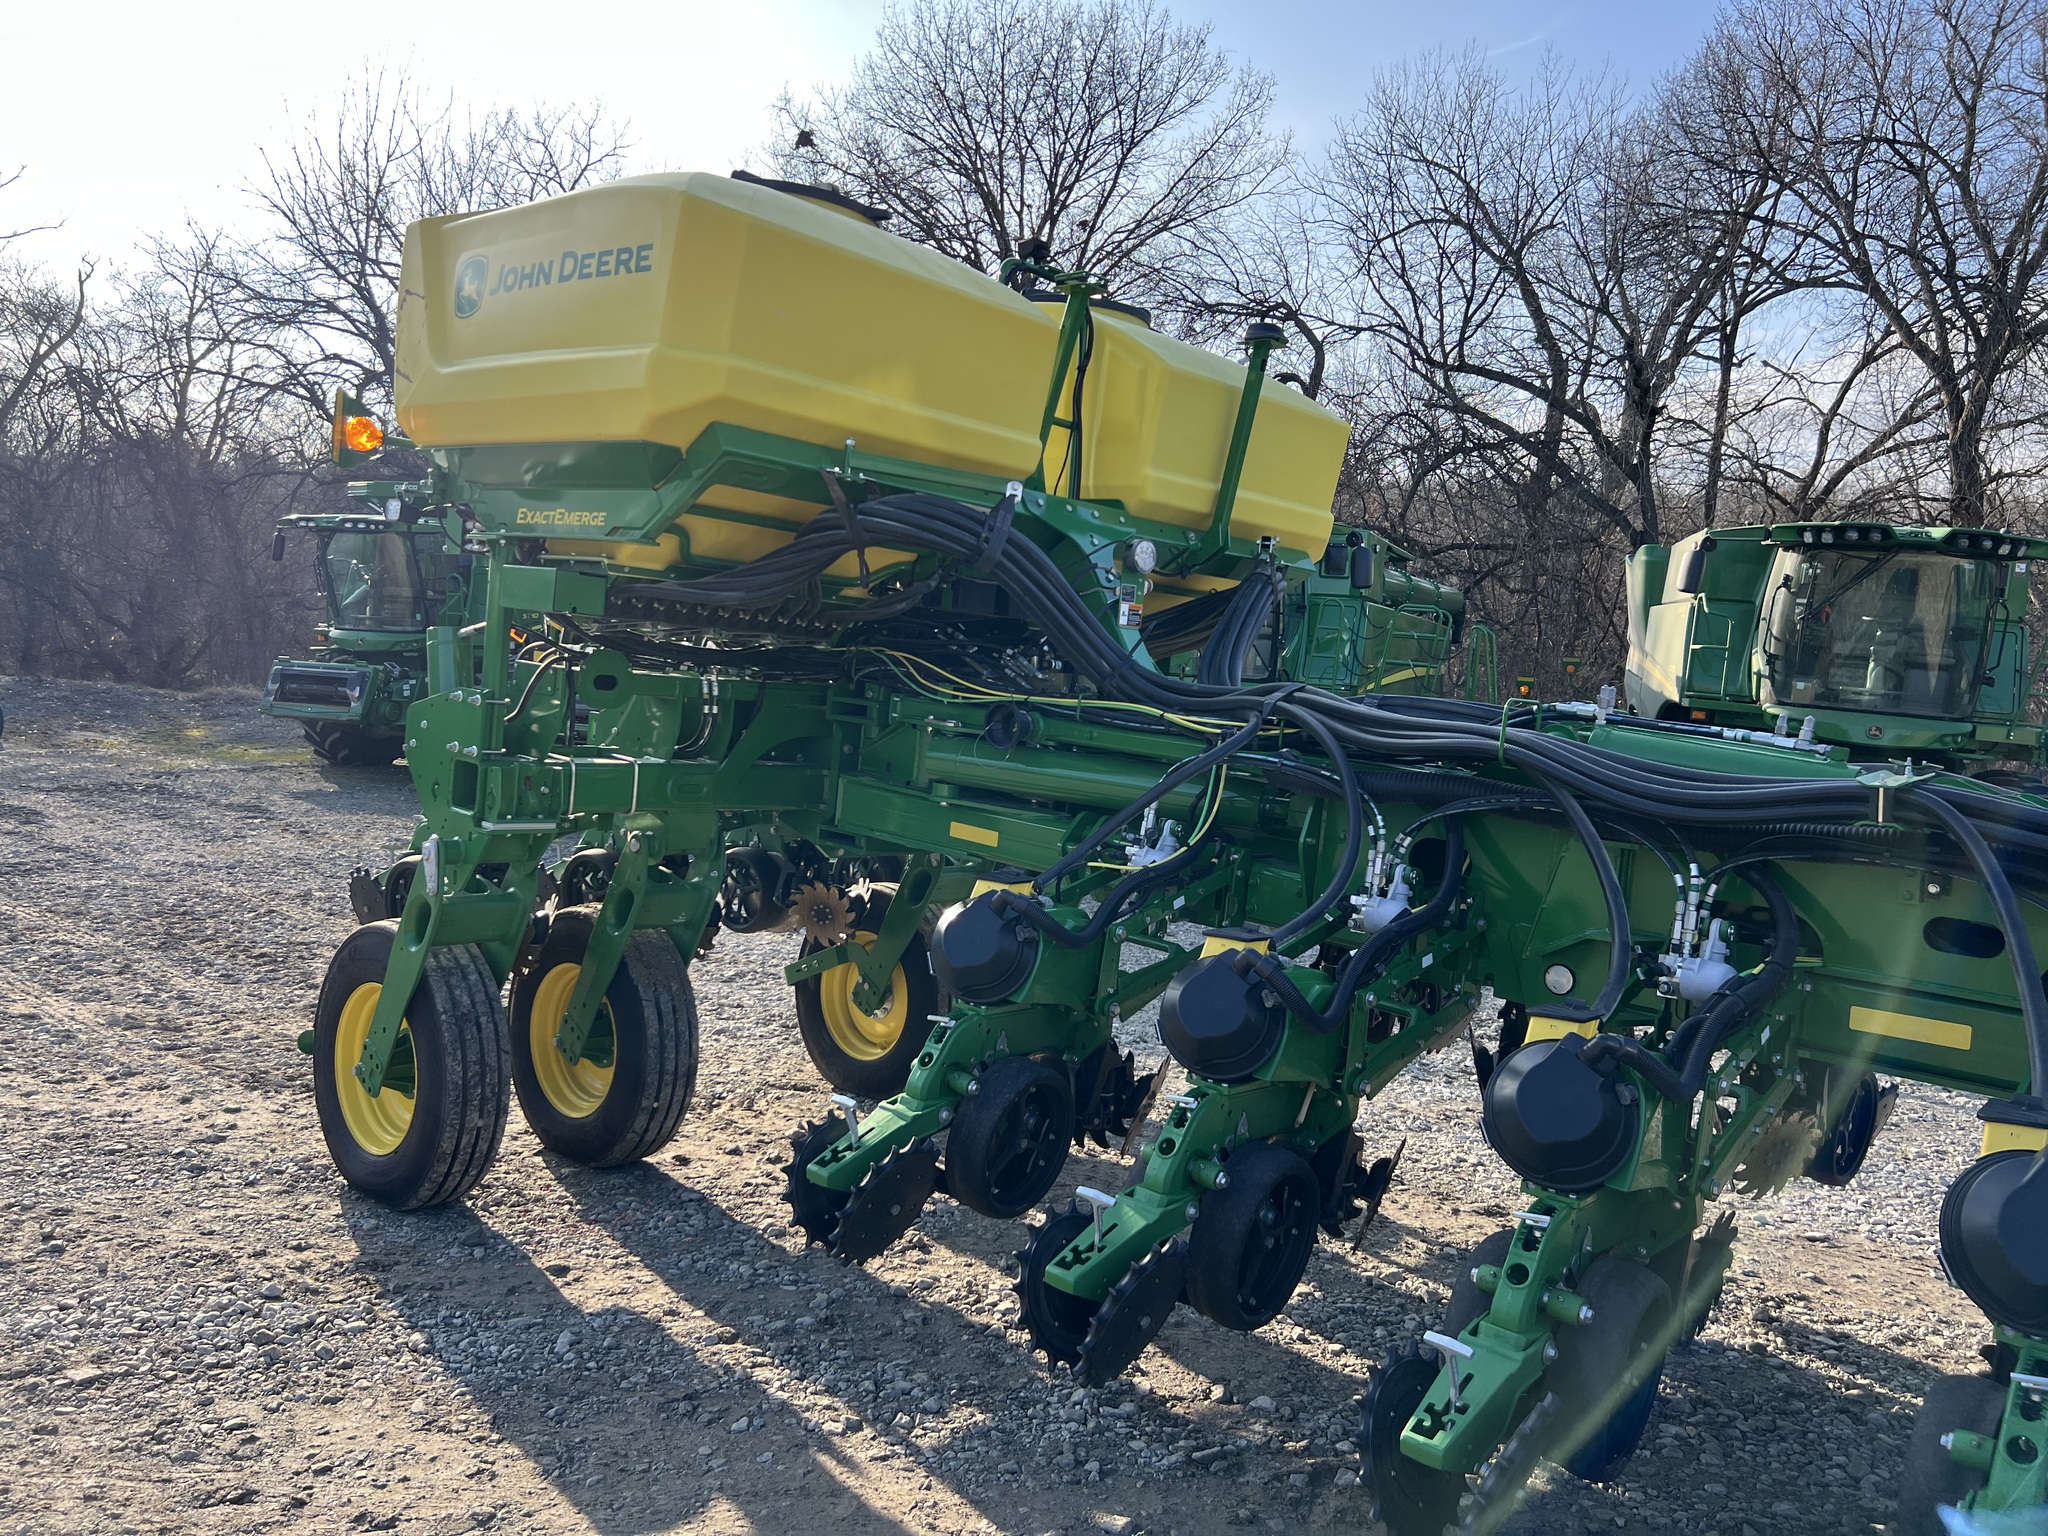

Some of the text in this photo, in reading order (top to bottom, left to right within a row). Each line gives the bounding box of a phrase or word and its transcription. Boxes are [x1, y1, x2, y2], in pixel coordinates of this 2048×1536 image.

[489, 243, 654, 297] JOHN DEERE
[516, 507, 607, 526] EXACTEMERGE
